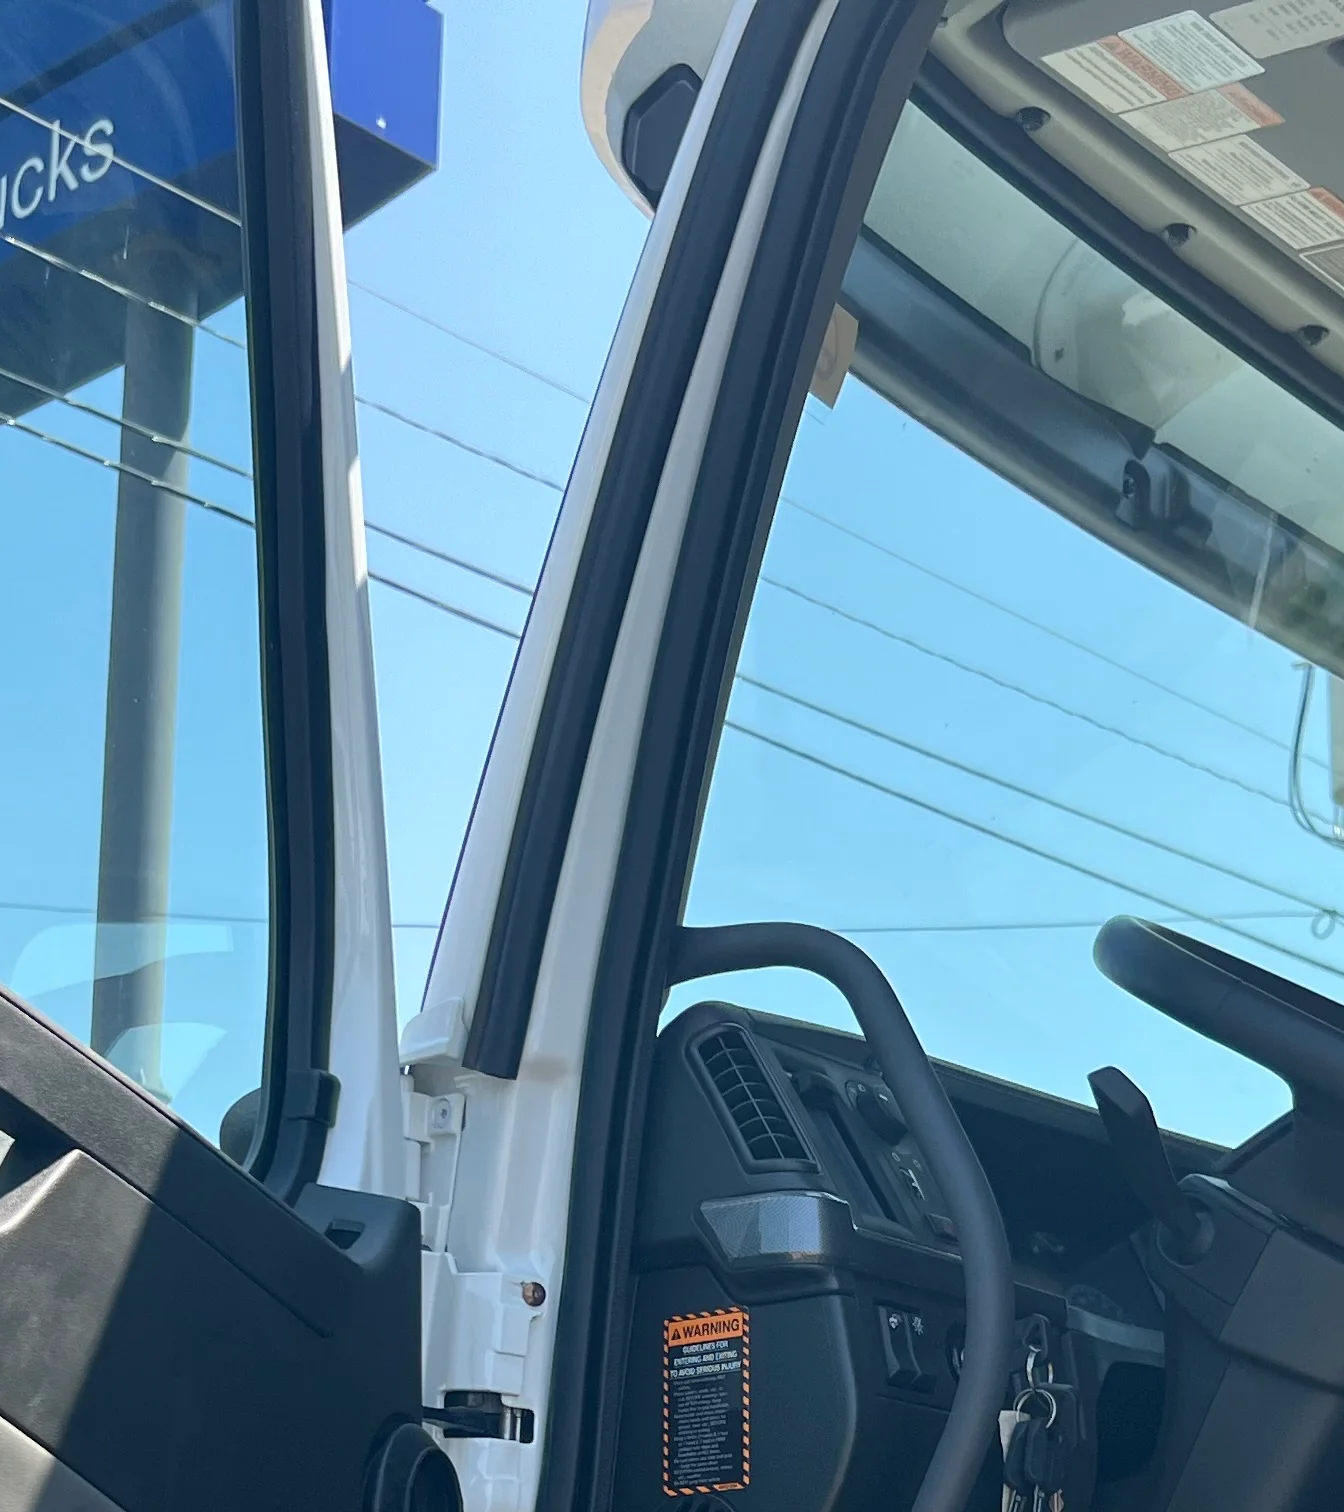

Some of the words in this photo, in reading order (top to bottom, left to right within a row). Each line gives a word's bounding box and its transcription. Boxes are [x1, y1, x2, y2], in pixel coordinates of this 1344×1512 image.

[683, 1319, 740, 1338] WARNING
[682, 1342, 716, 1353] GUIDELINES
[716, 1341, 729, 1349] FOR
[673, 1355, 702, 1366] ENTERING
[703, 1353, 715, 1362] AND
[715, 1350, 738, 1360] EXITING
[670, 1370, 678, 1378] TO
[678, 1368, 695, 1376] AVOID
[696, 1364, 721, 1374] SERIOUS
[721, 1361, 742, 1370] INJURY
